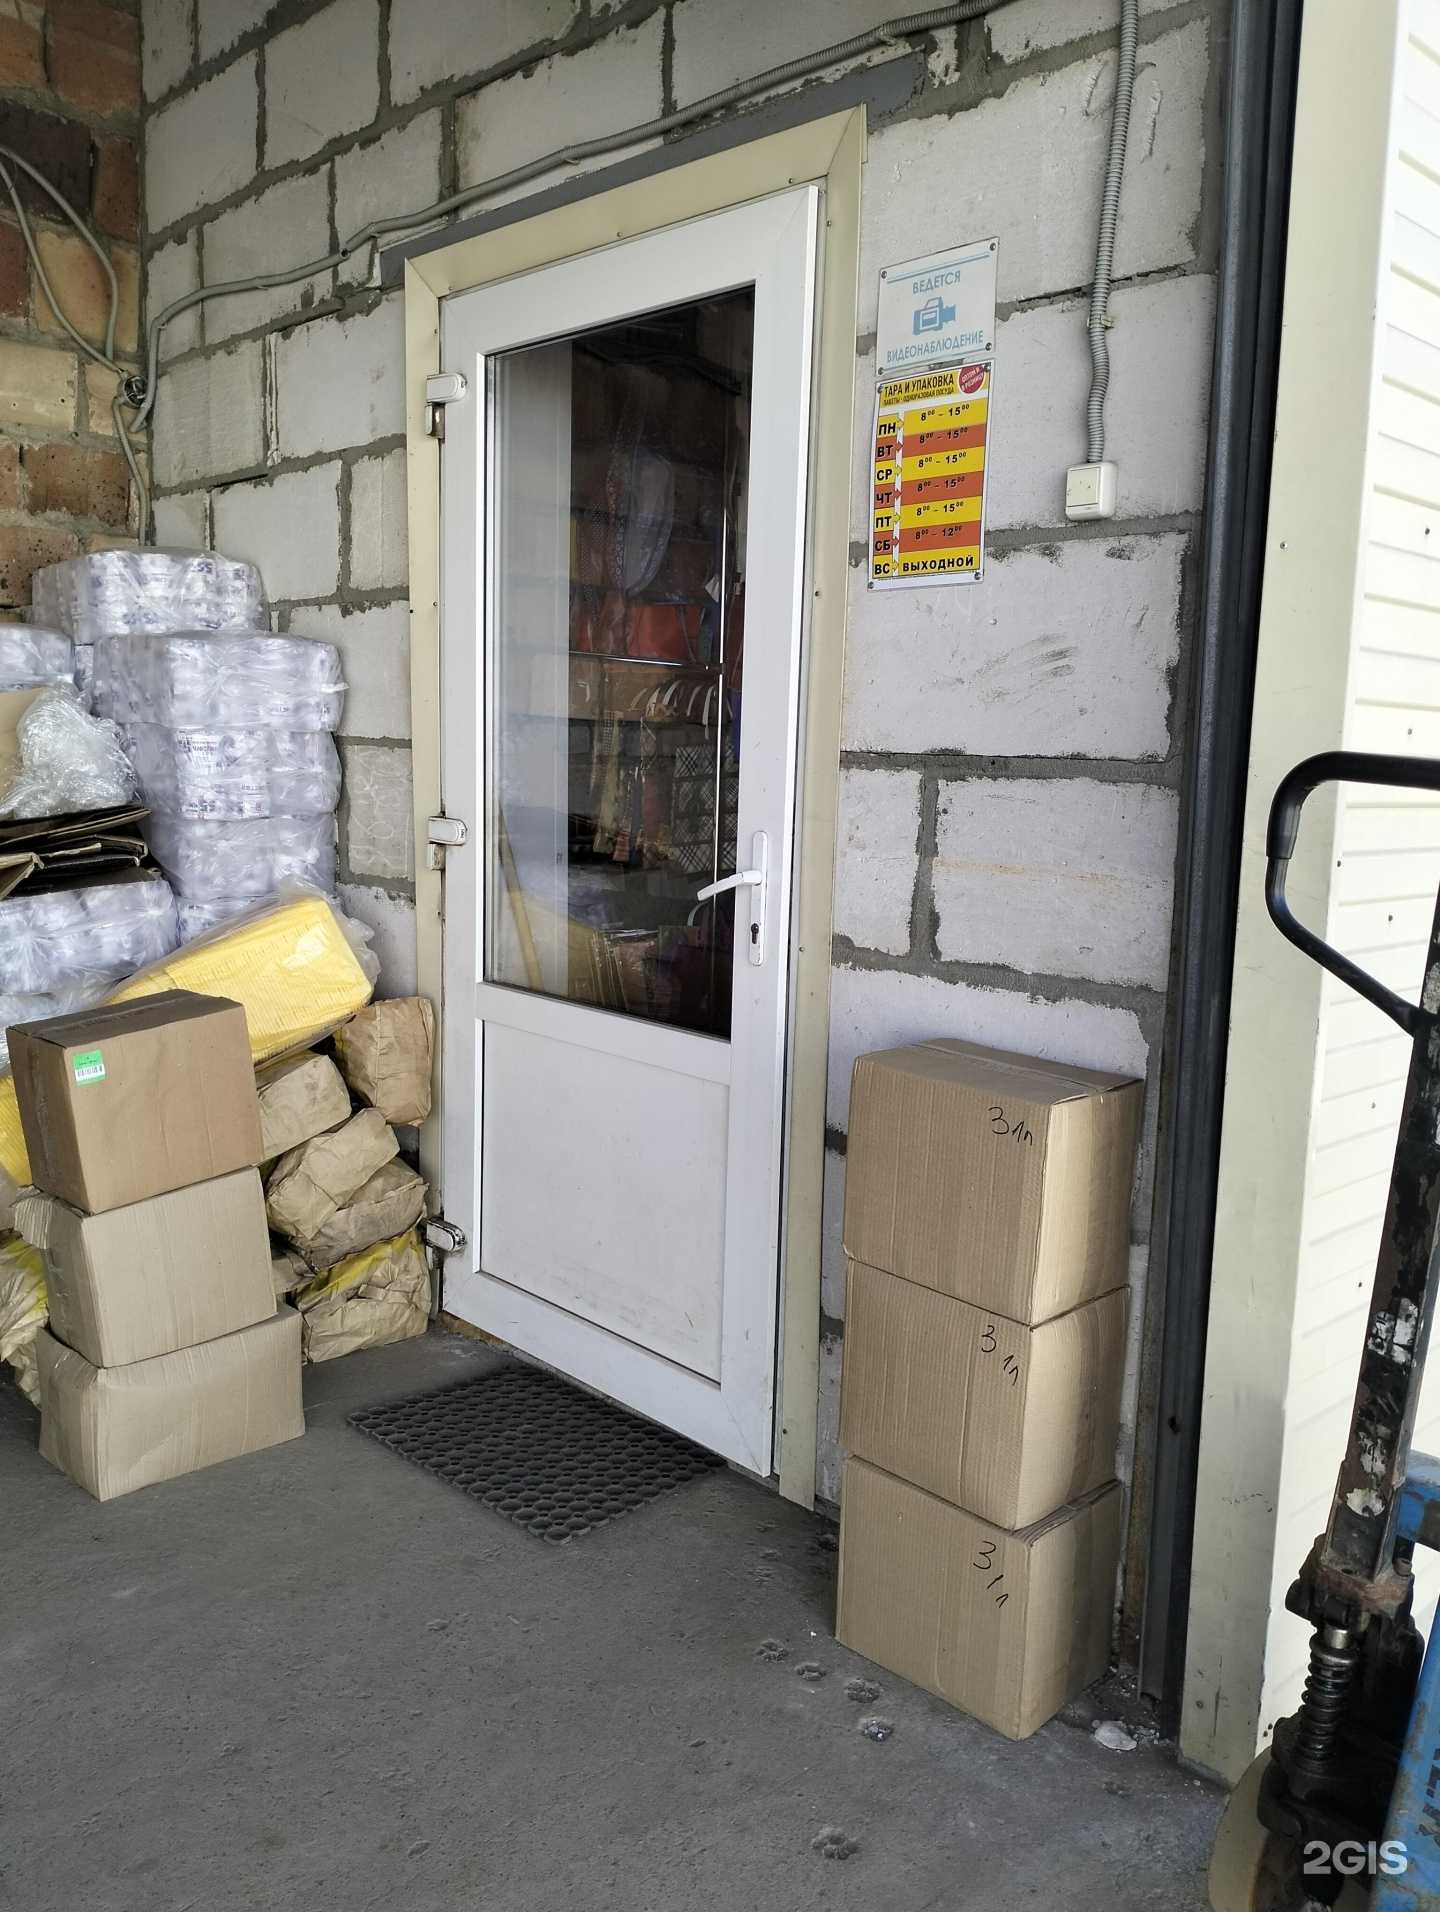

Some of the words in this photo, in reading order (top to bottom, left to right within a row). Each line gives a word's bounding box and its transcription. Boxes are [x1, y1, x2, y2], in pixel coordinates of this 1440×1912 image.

[912, 270, 961, 294] ВЕДЕТСЯ
[887, 330, 984, 363] ВИДЕОНАБЛЮДЕНИЕ
[884, 383, 903, 398] ТАРА
[904, 381, 910, 394] И
[911, 373, 954, 393] УПАКОВКА
[878, 422, 896, 436] ПН
[877, 444, 893, 458] ВТ
[876, 468, 892, 481] СР
[875, 491, 892, 504] ЧТ
[875, 515, 892, 529] ПТ
[874, 539, 891, 552] СБ
[874, 563, 890, 575] ВС
[902, 554, 974, 572] ВЫХОДНОЙ
